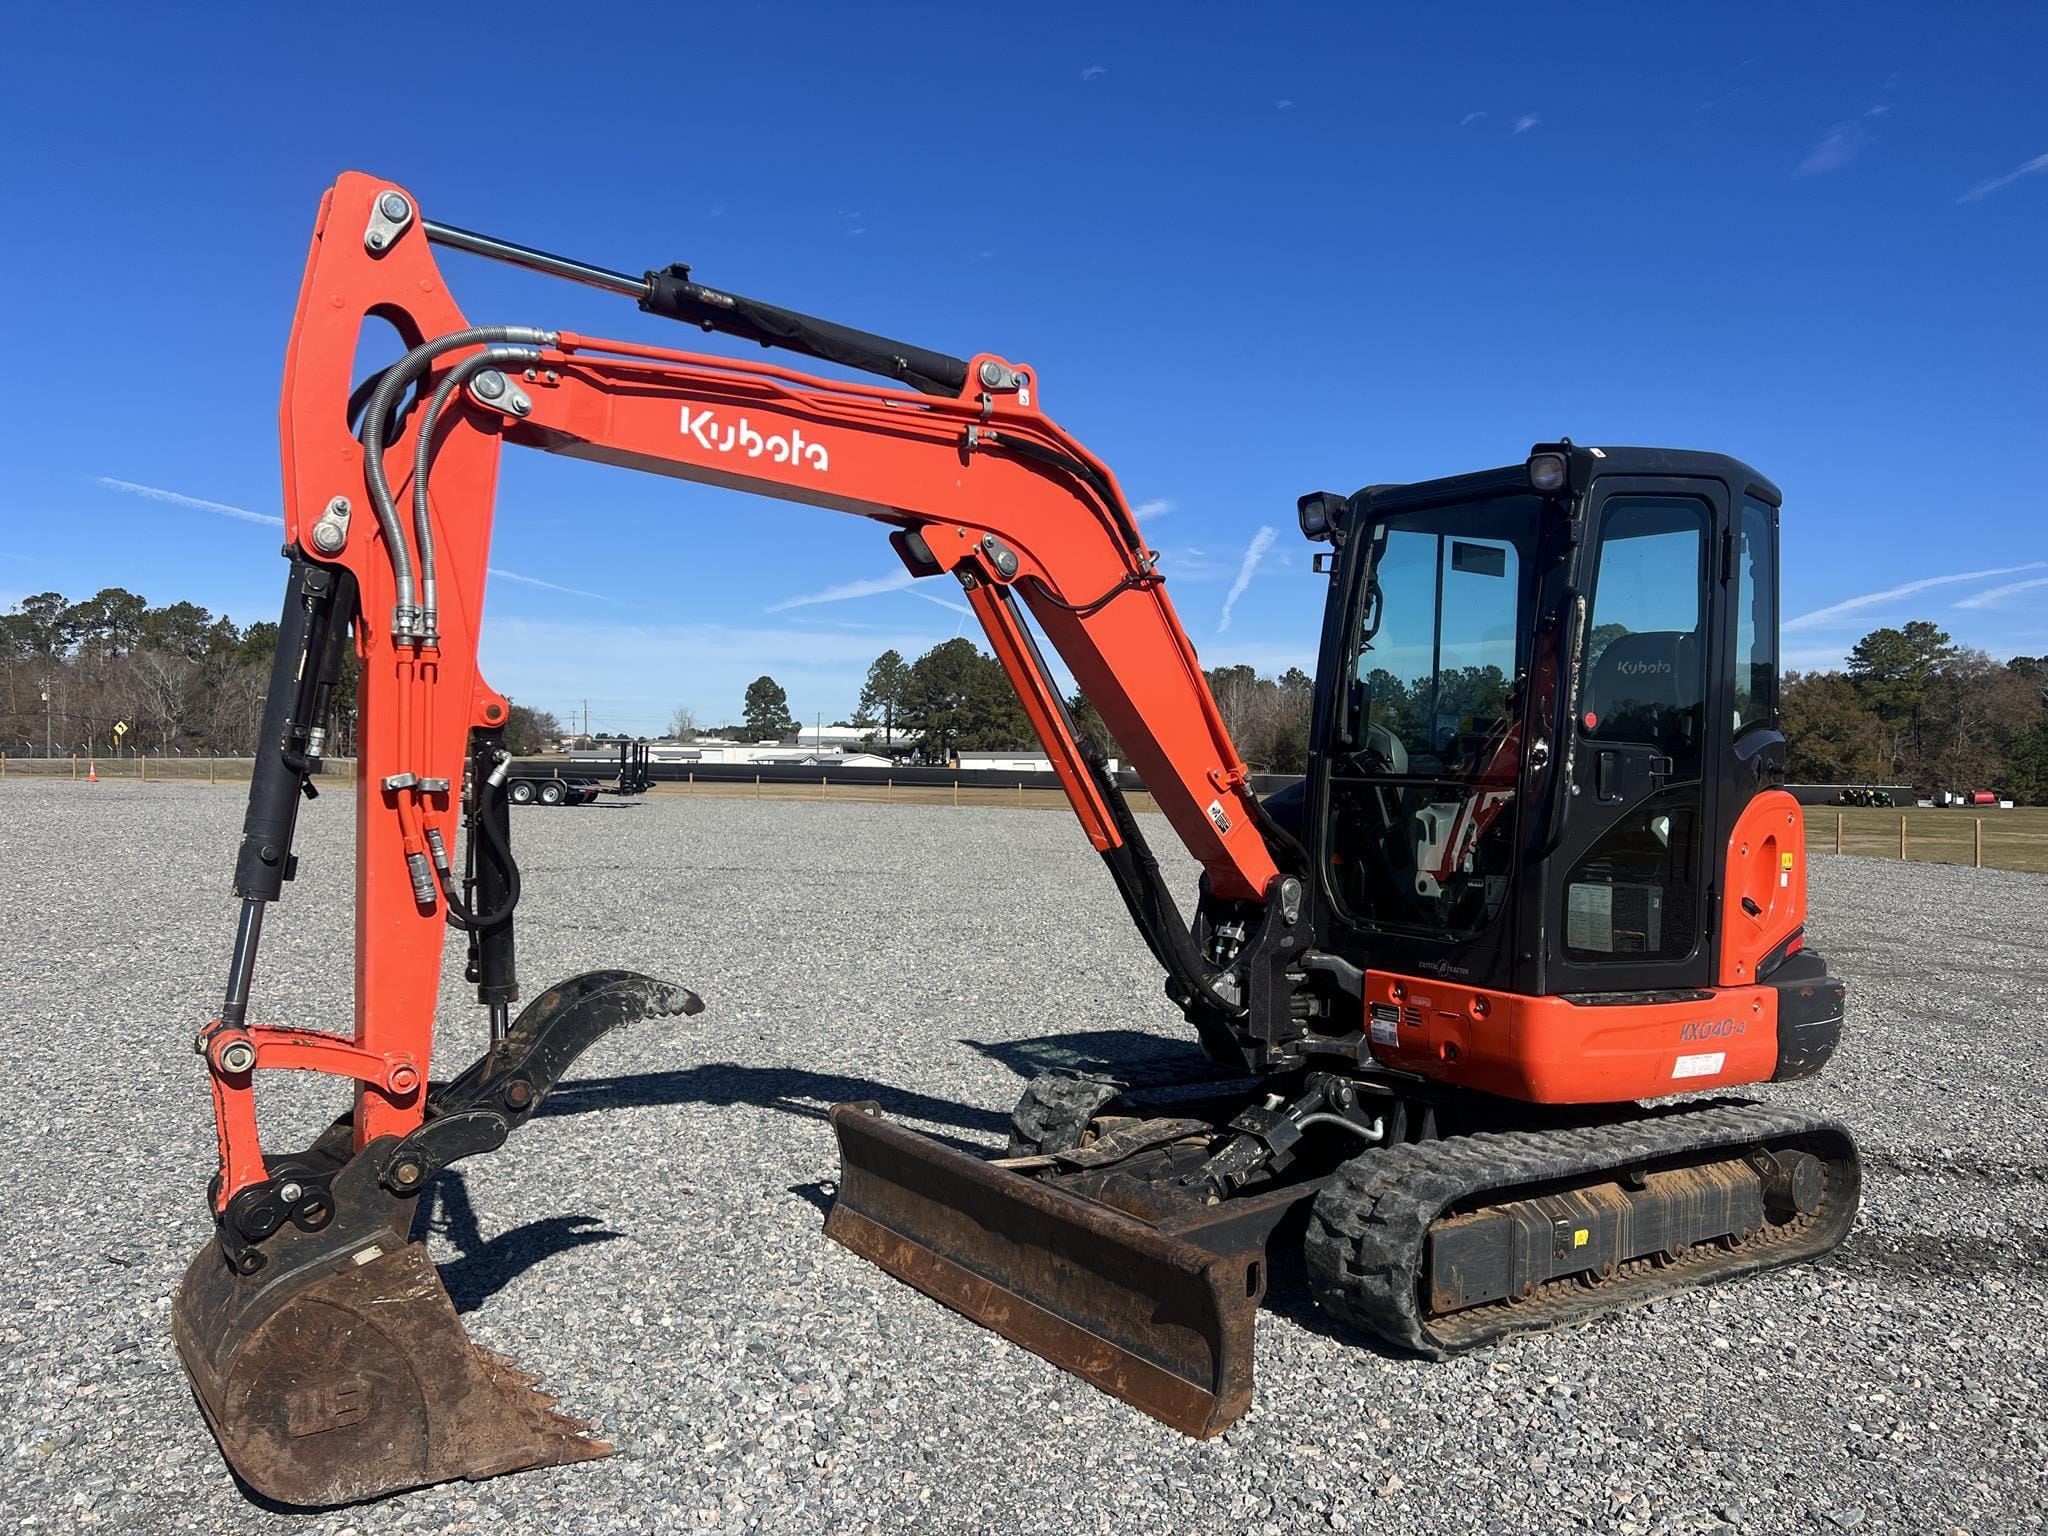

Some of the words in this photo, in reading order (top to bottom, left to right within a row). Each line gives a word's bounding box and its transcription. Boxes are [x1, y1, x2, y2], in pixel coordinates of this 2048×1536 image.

[680, 406, 829, 472] Kubota
[1617, 660, 1671, 674] Kubota
[1680, 1018, 1746, 1042] KX040-4
